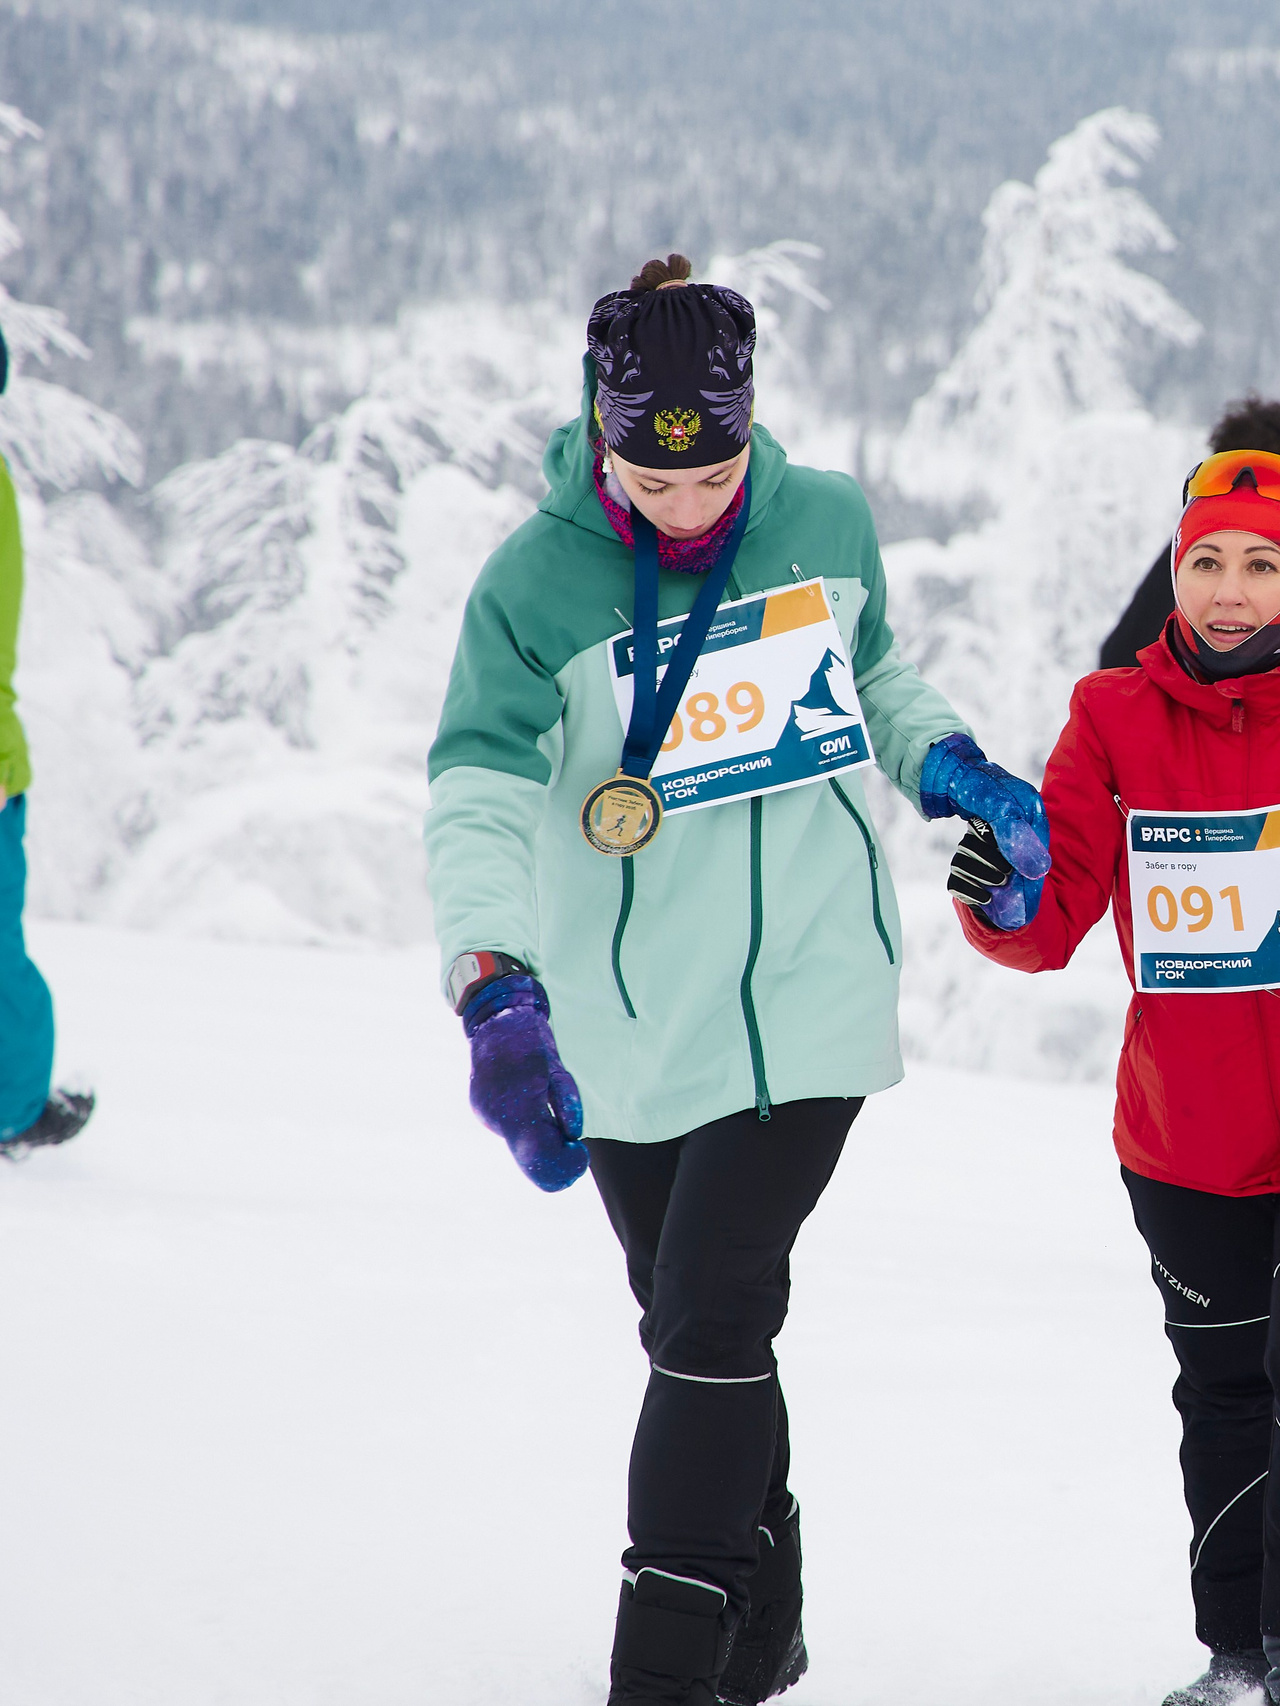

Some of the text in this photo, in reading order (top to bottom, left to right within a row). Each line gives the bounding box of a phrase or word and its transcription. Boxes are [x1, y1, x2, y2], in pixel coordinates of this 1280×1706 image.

[709, 620, 736, 632] ершина
[662, 756, 772, 791] КОВДОРСКИЙ
[664, 787, 699, 802] ГОК
[1204, 828, 1234, 836] Вершина
[1205, 834, 1244, 842] Гипербореи
[1145, 861, 1169, 870] Забег
[1178, 863, 1197, 872] гору
[1147, 885, 1245, 933] 091
[1155, 956, 1252, 970] КОВДОРСКИЙ
[1156, 970, 1185, 980] ГОК
